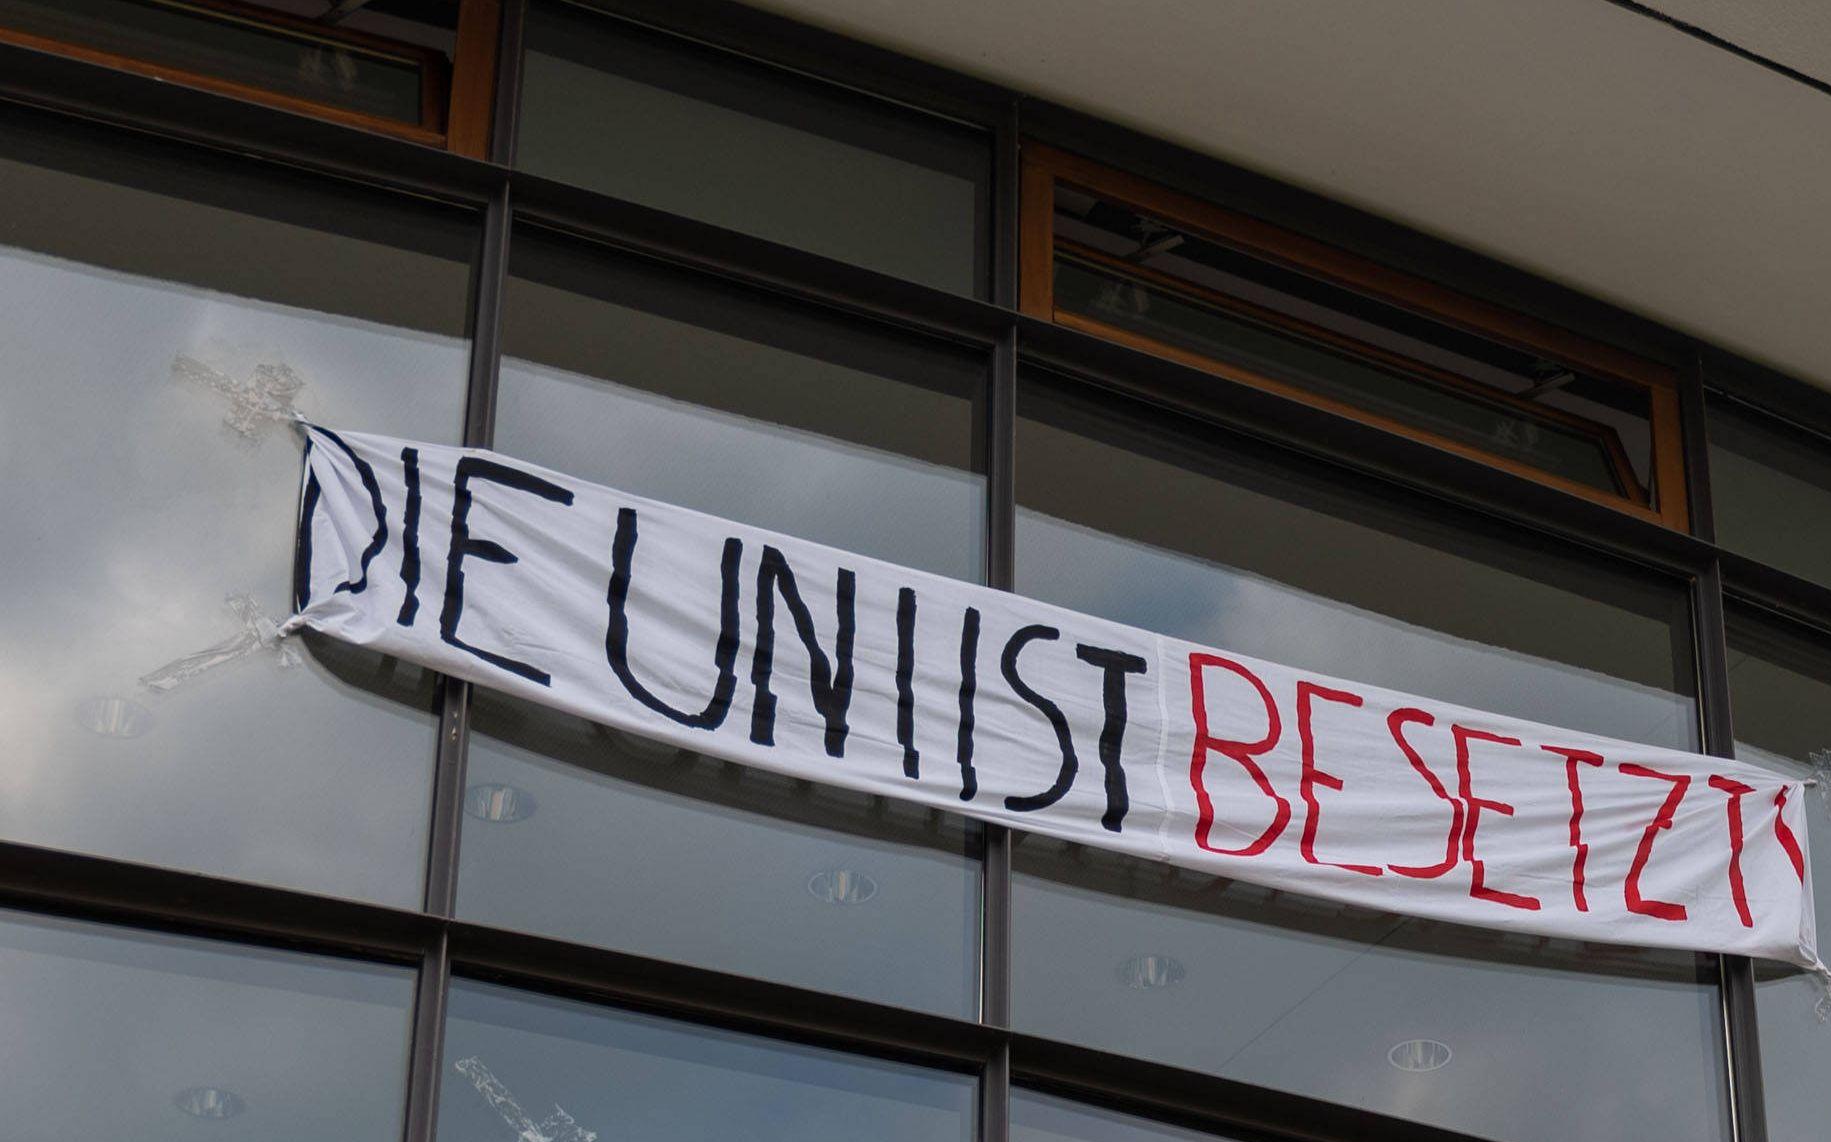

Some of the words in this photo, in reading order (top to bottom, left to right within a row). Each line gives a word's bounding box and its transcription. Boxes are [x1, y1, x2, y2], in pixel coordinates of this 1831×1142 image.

[294, 425, 574, 687] DIE
[606, 508, 919, 779] UNI
[957, 607, 1147, 832] IST
